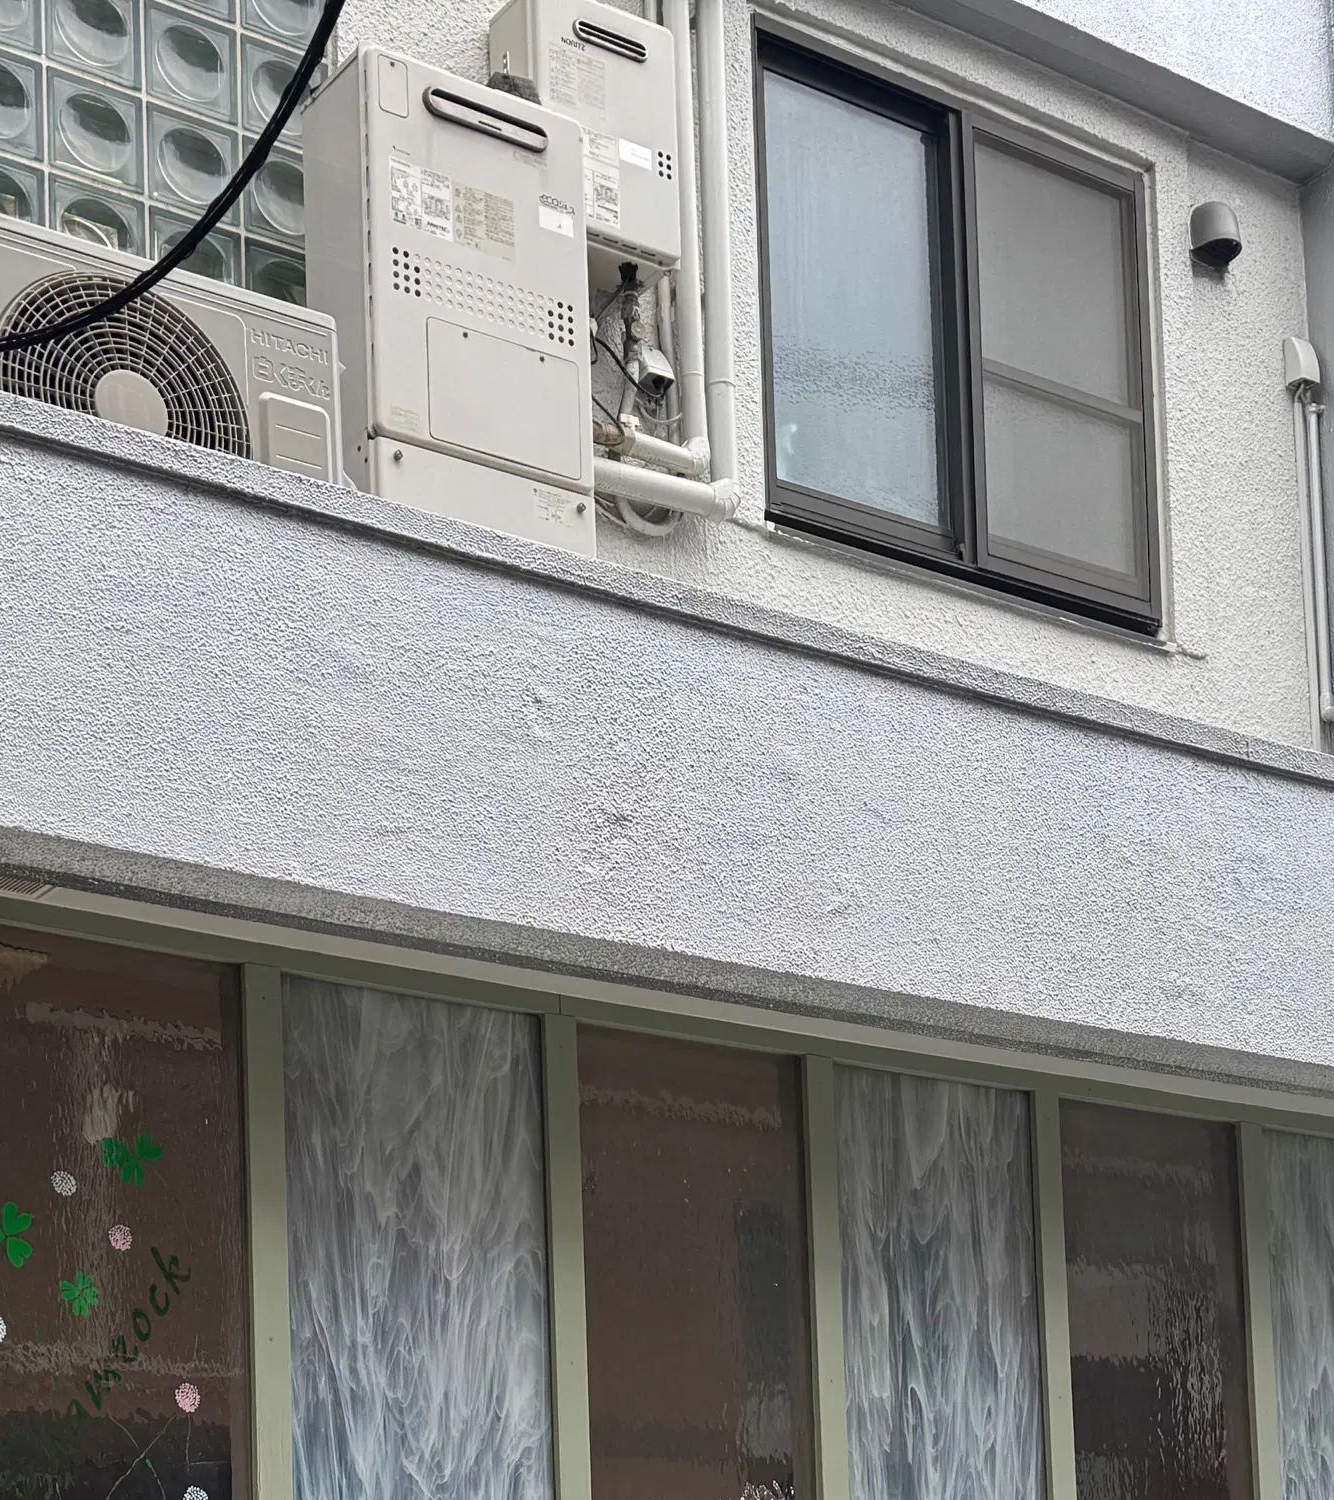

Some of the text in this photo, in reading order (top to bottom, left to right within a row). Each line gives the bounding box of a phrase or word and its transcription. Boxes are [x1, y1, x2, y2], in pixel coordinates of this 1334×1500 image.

[560, 36, 586, 51] NORITZ
[250, 328, 329, 366] HITACHI
[252, 355, 331, 401] 白くまくん
